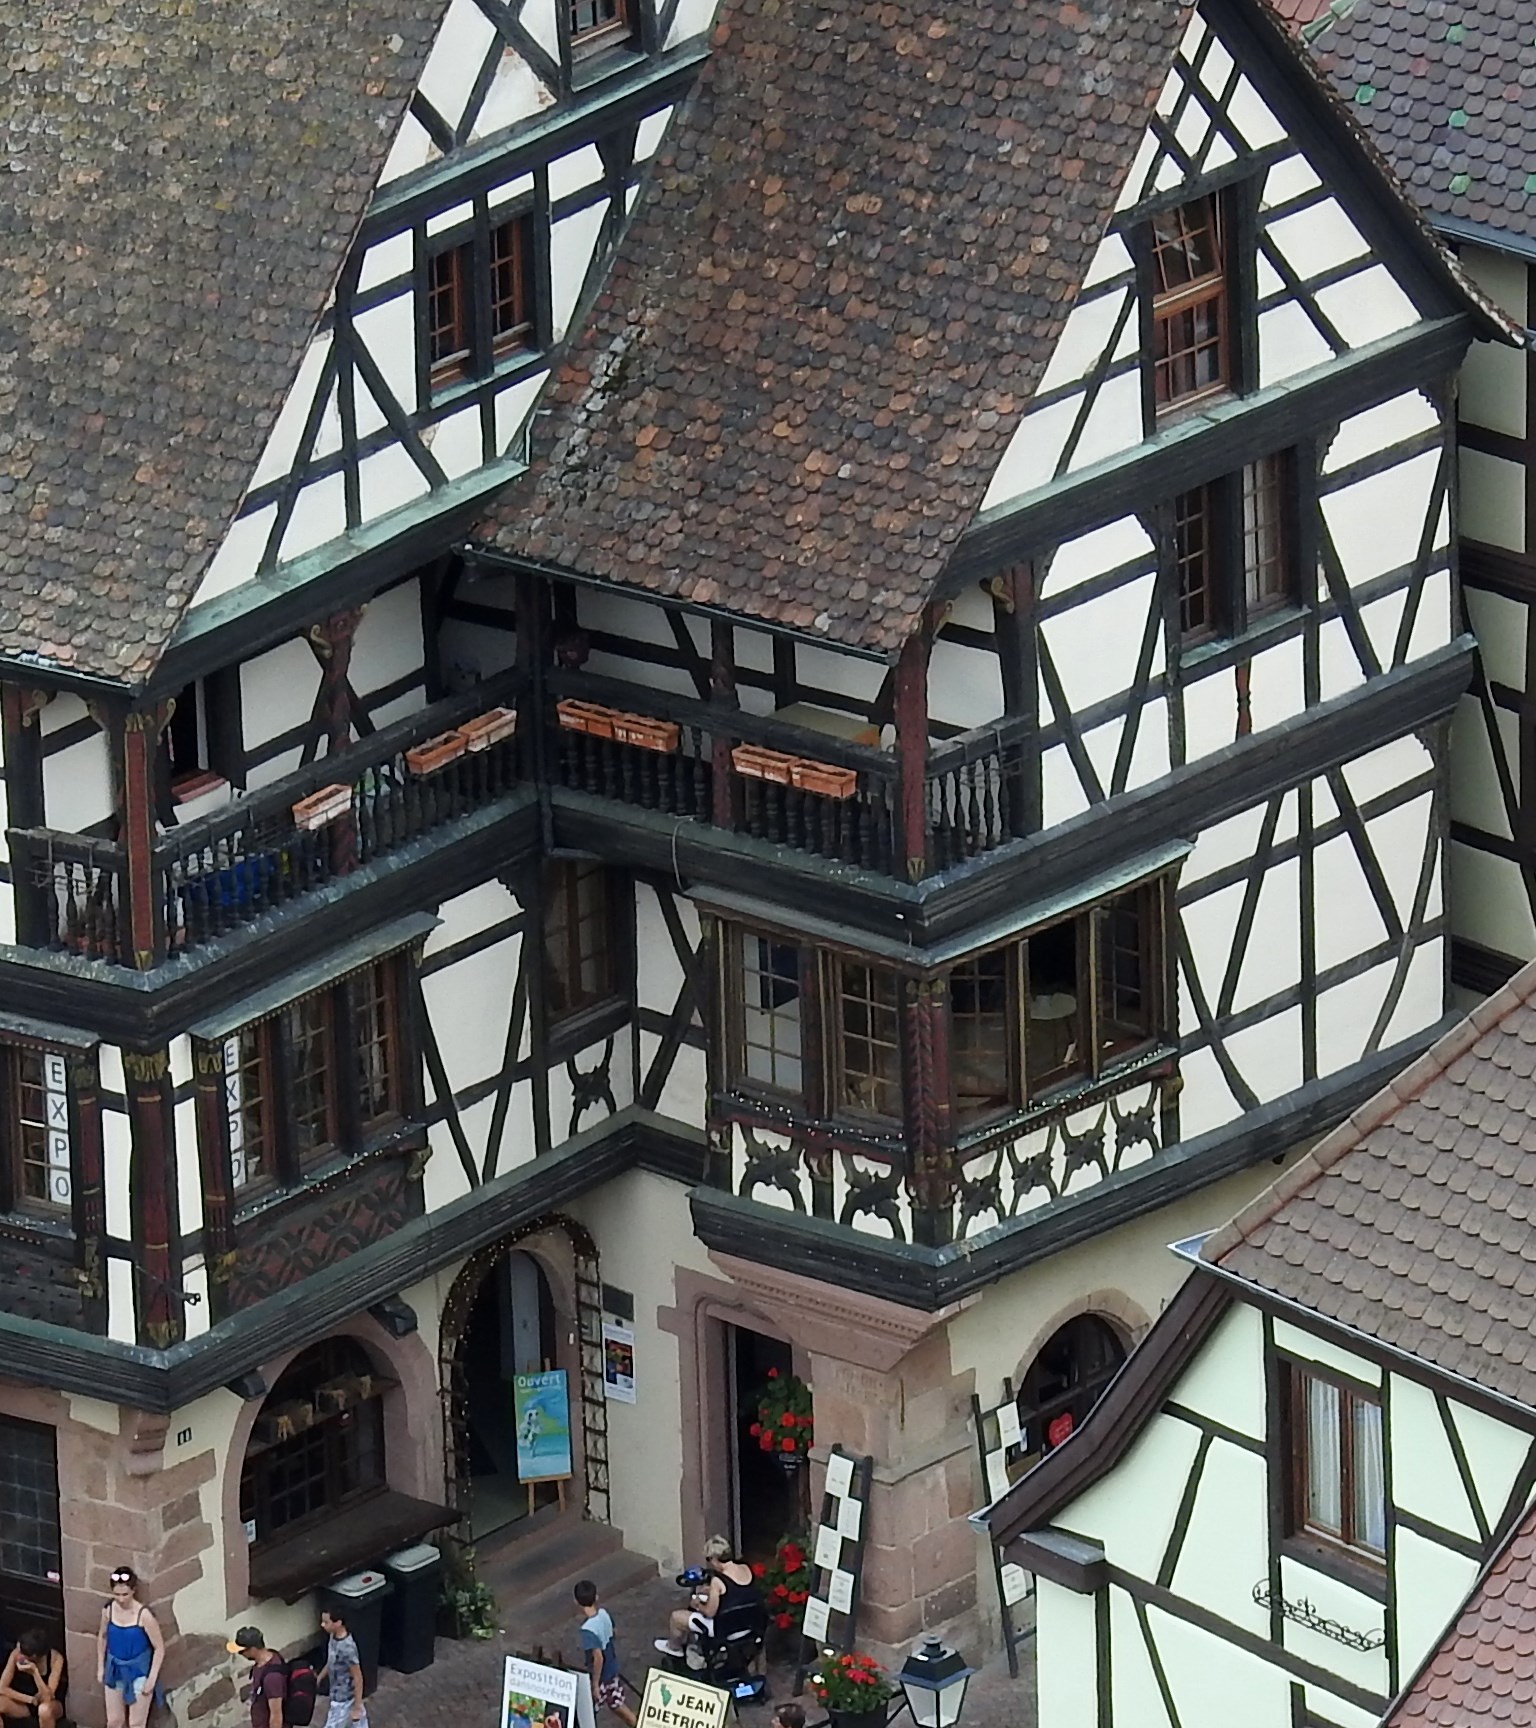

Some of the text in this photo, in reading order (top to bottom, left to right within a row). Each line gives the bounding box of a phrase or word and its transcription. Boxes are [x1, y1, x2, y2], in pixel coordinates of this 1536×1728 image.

[51, 1061, 70, 1197] EXPO
[517, 1373, 561, 1388] Ouvert
[510, 1663, 572, 1690] Exposition
[677, 1694, 716, 1715] JEAN
